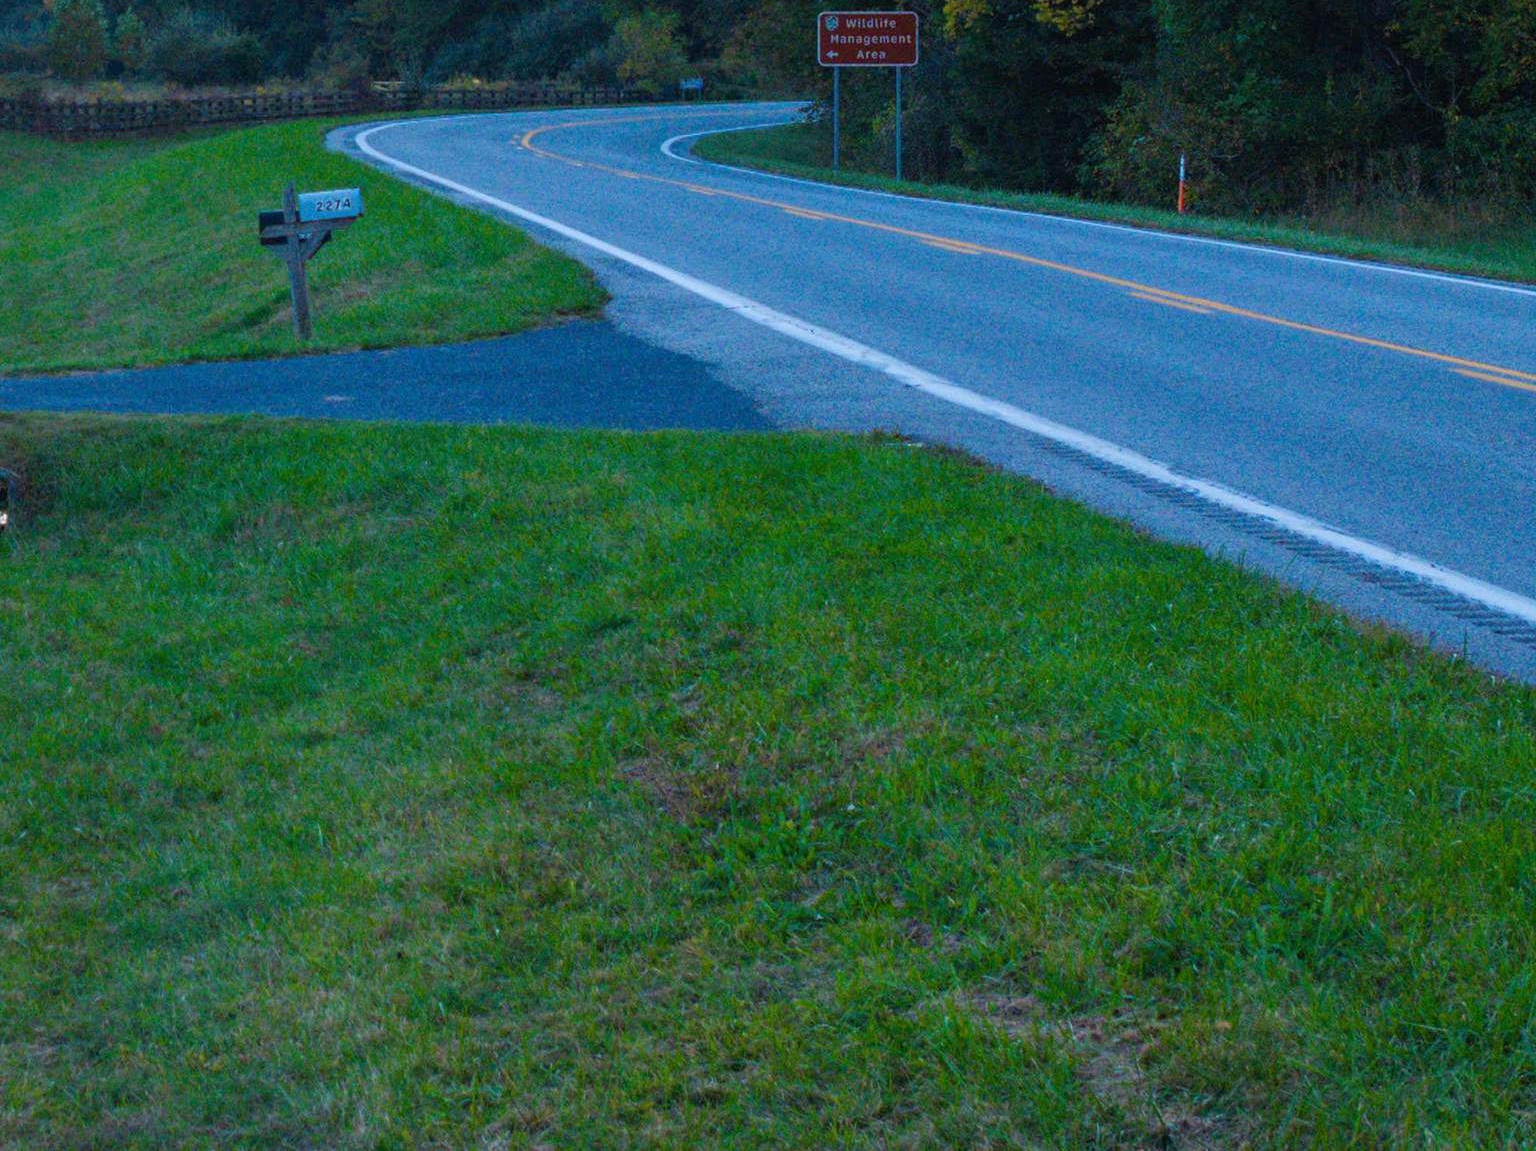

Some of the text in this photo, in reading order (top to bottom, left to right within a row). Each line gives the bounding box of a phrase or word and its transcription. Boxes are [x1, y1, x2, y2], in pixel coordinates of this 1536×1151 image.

[845, 18, 896, 28] Wildlife
[830, 34, 911, 45] Management
[856, 50, 886, 59] Area
[316, 198, 351, 212] 2274
